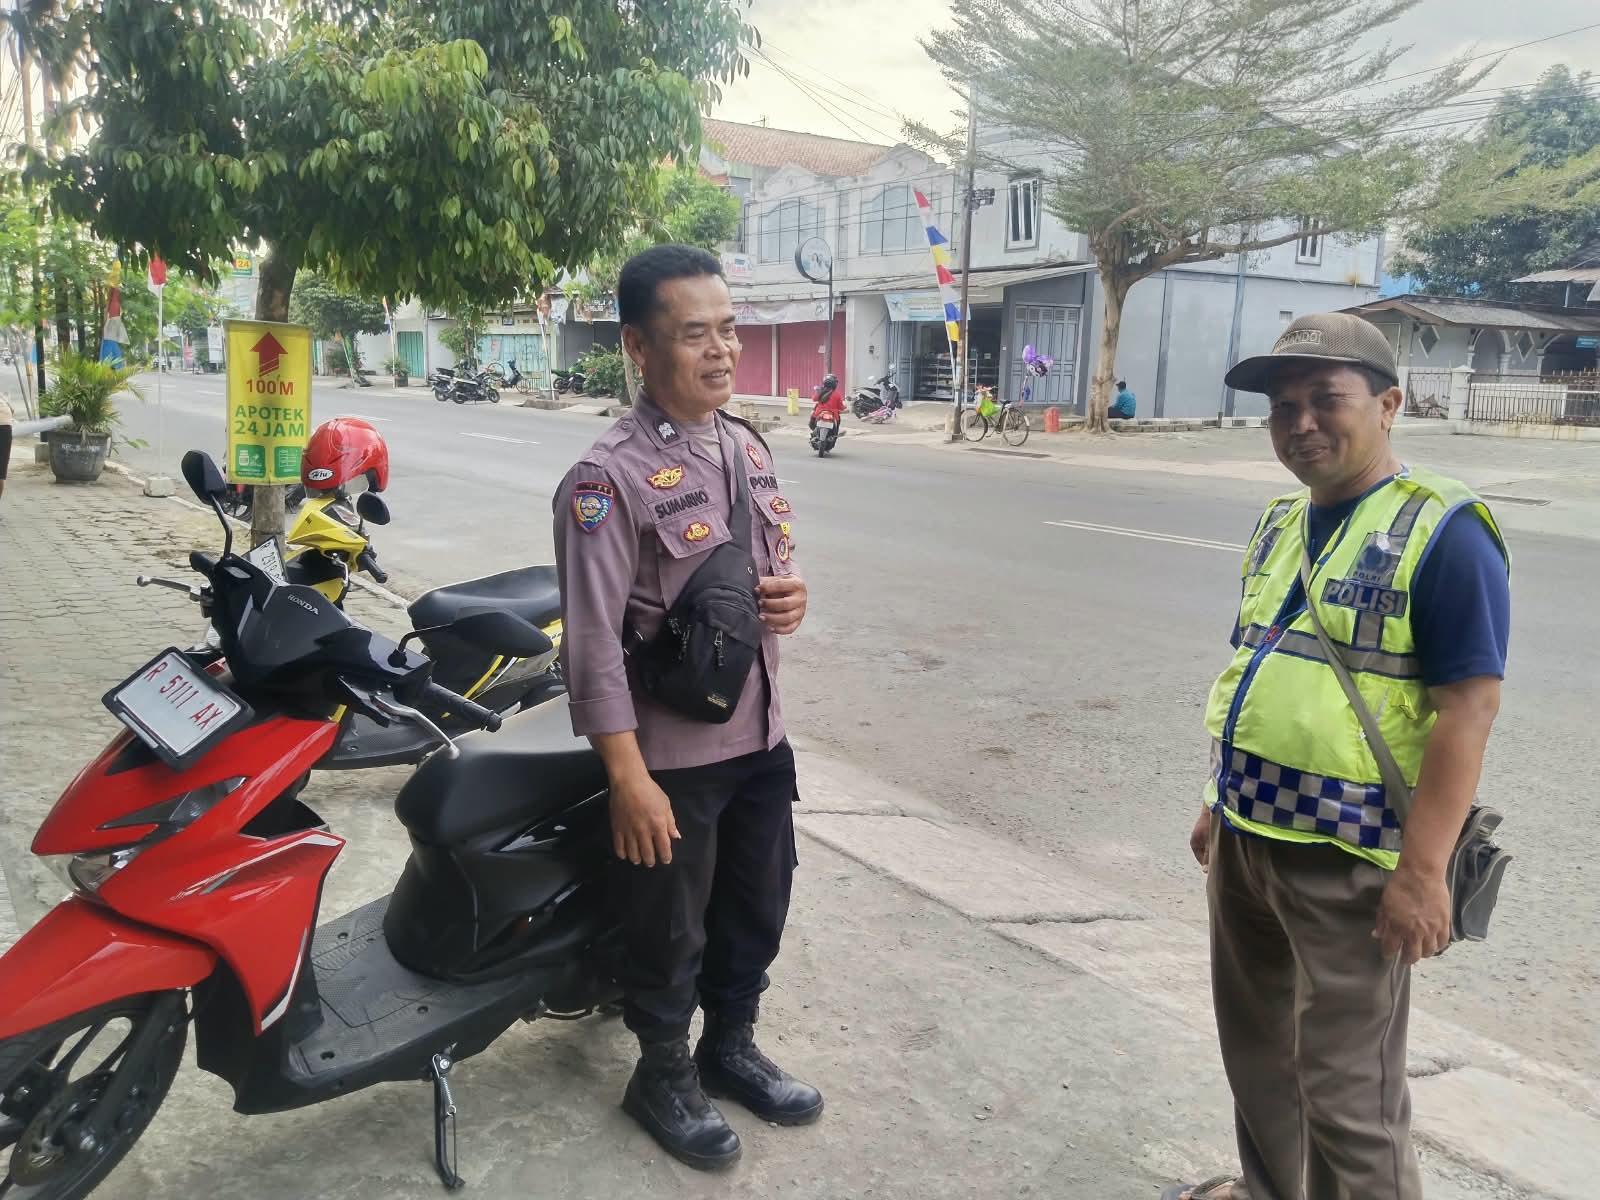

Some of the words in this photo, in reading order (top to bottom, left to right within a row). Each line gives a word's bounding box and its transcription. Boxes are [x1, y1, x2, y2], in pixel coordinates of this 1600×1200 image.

[235, 405, 304, 421] APOTEK
[234, 421, 258, 435] 24
[263, 422, 304, 437] JAM
[654, 490, 710, 519] SUMARNO
[288, 594, 319, 615] HONDA
[1325, 581, 1405, 615] POLISI
[144, 661, 168, 682] R
[159, 674, 199, 709] 5111
[190, 702, 223, 730] AX
